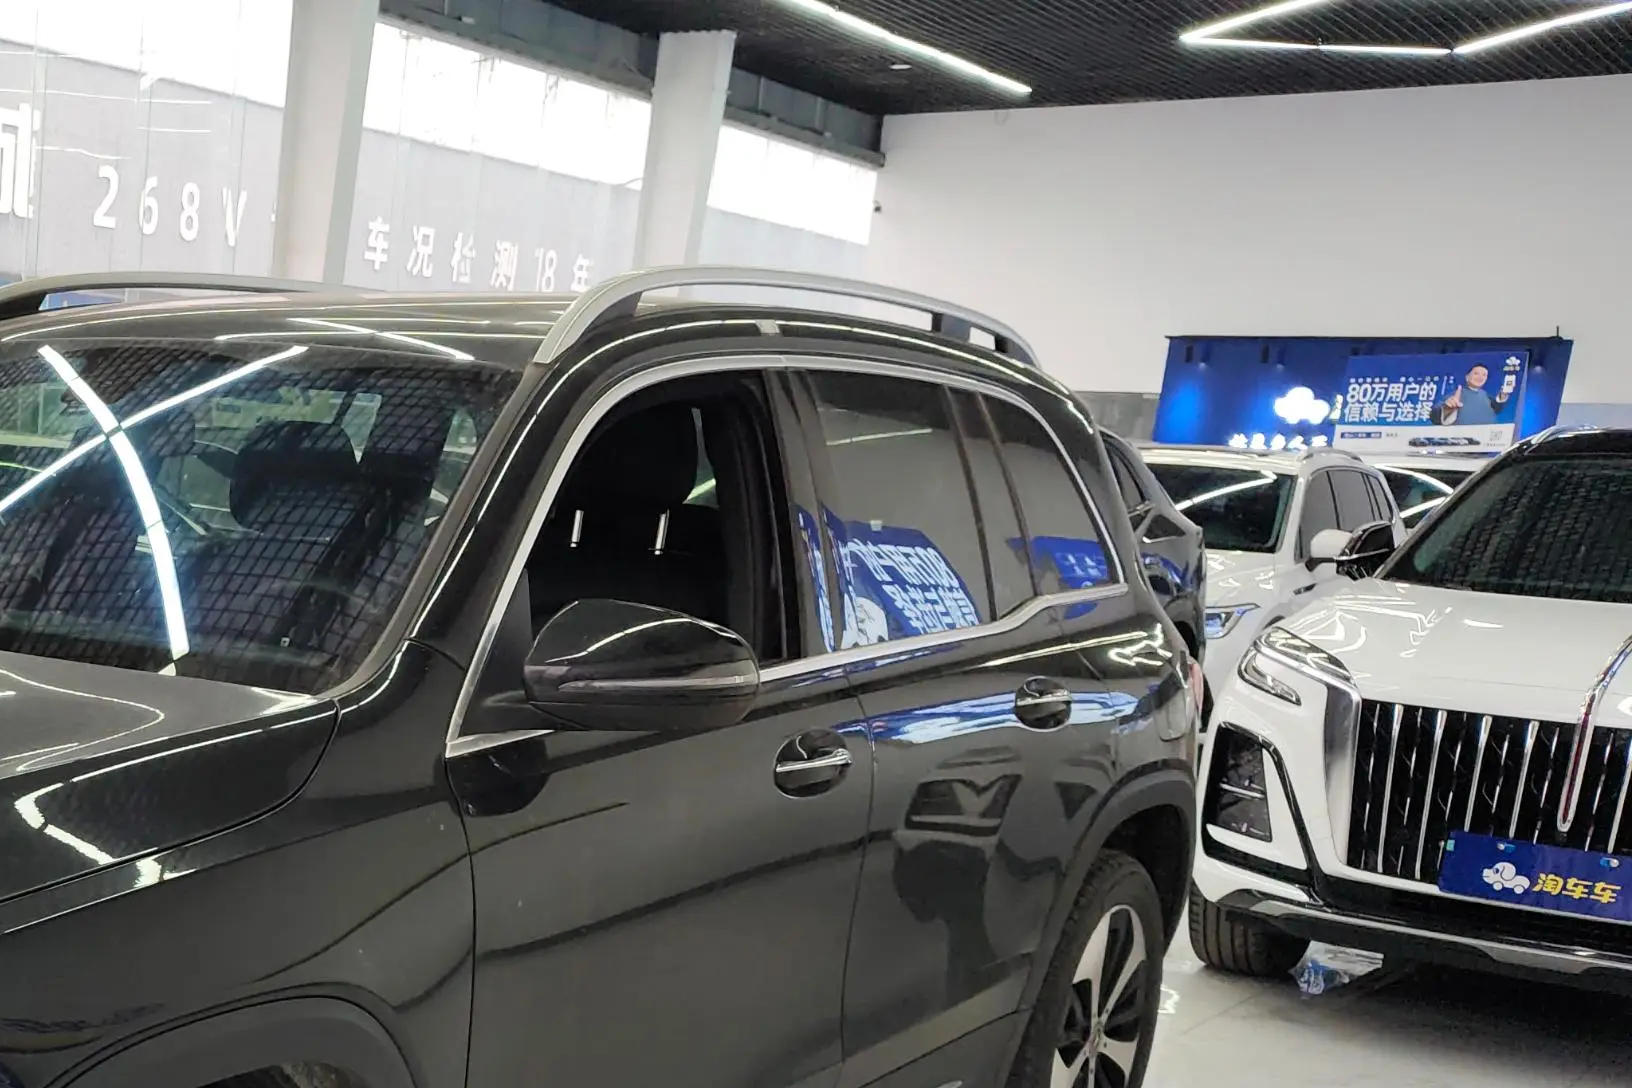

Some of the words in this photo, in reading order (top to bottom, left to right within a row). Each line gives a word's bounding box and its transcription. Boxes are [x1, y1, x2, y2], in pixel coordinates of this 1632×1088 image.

[93, 165, 276, 247] 268V
[1346, 381, 1437, 403] 80万用户的
[1343, 401, 1434, 423] 信赖与选择
[1532, 872, 1622, 904] 淘车车
